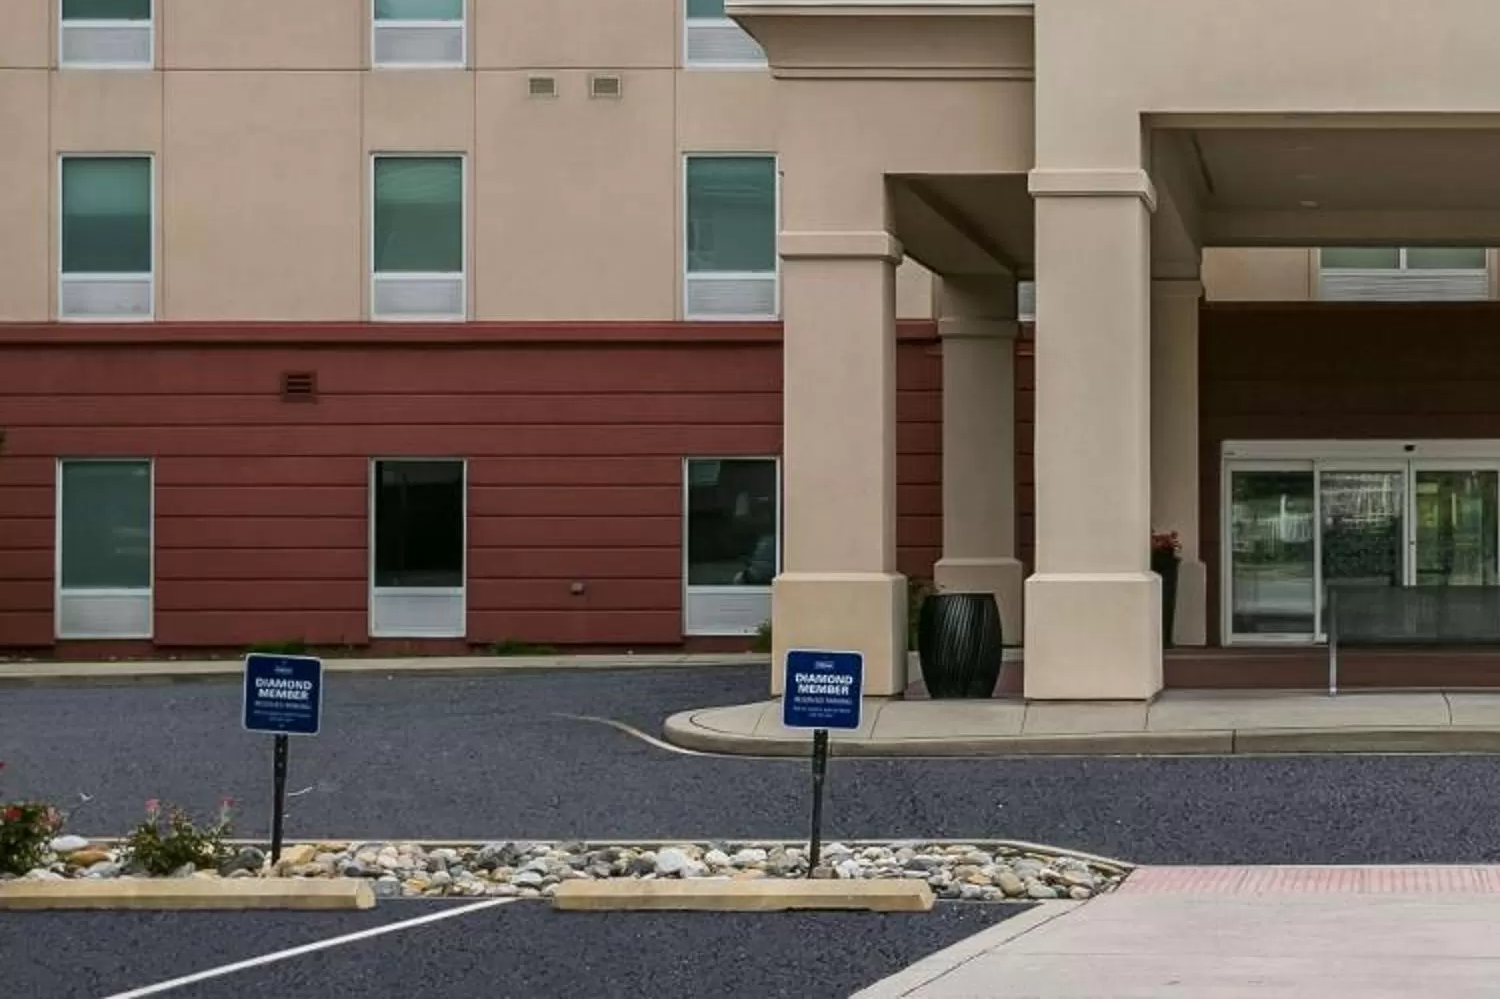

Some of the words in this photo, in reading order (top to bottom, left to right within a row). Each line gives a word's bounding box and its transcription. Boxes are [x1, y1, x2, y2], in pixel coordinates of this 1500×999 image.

[255, 677, 313, 690] DIAMOND
[795, 672, 853, 685] DIAMOND
[258, 688, 310, 700] MEMBER
[797, 684, 849, 696] MEMBER
